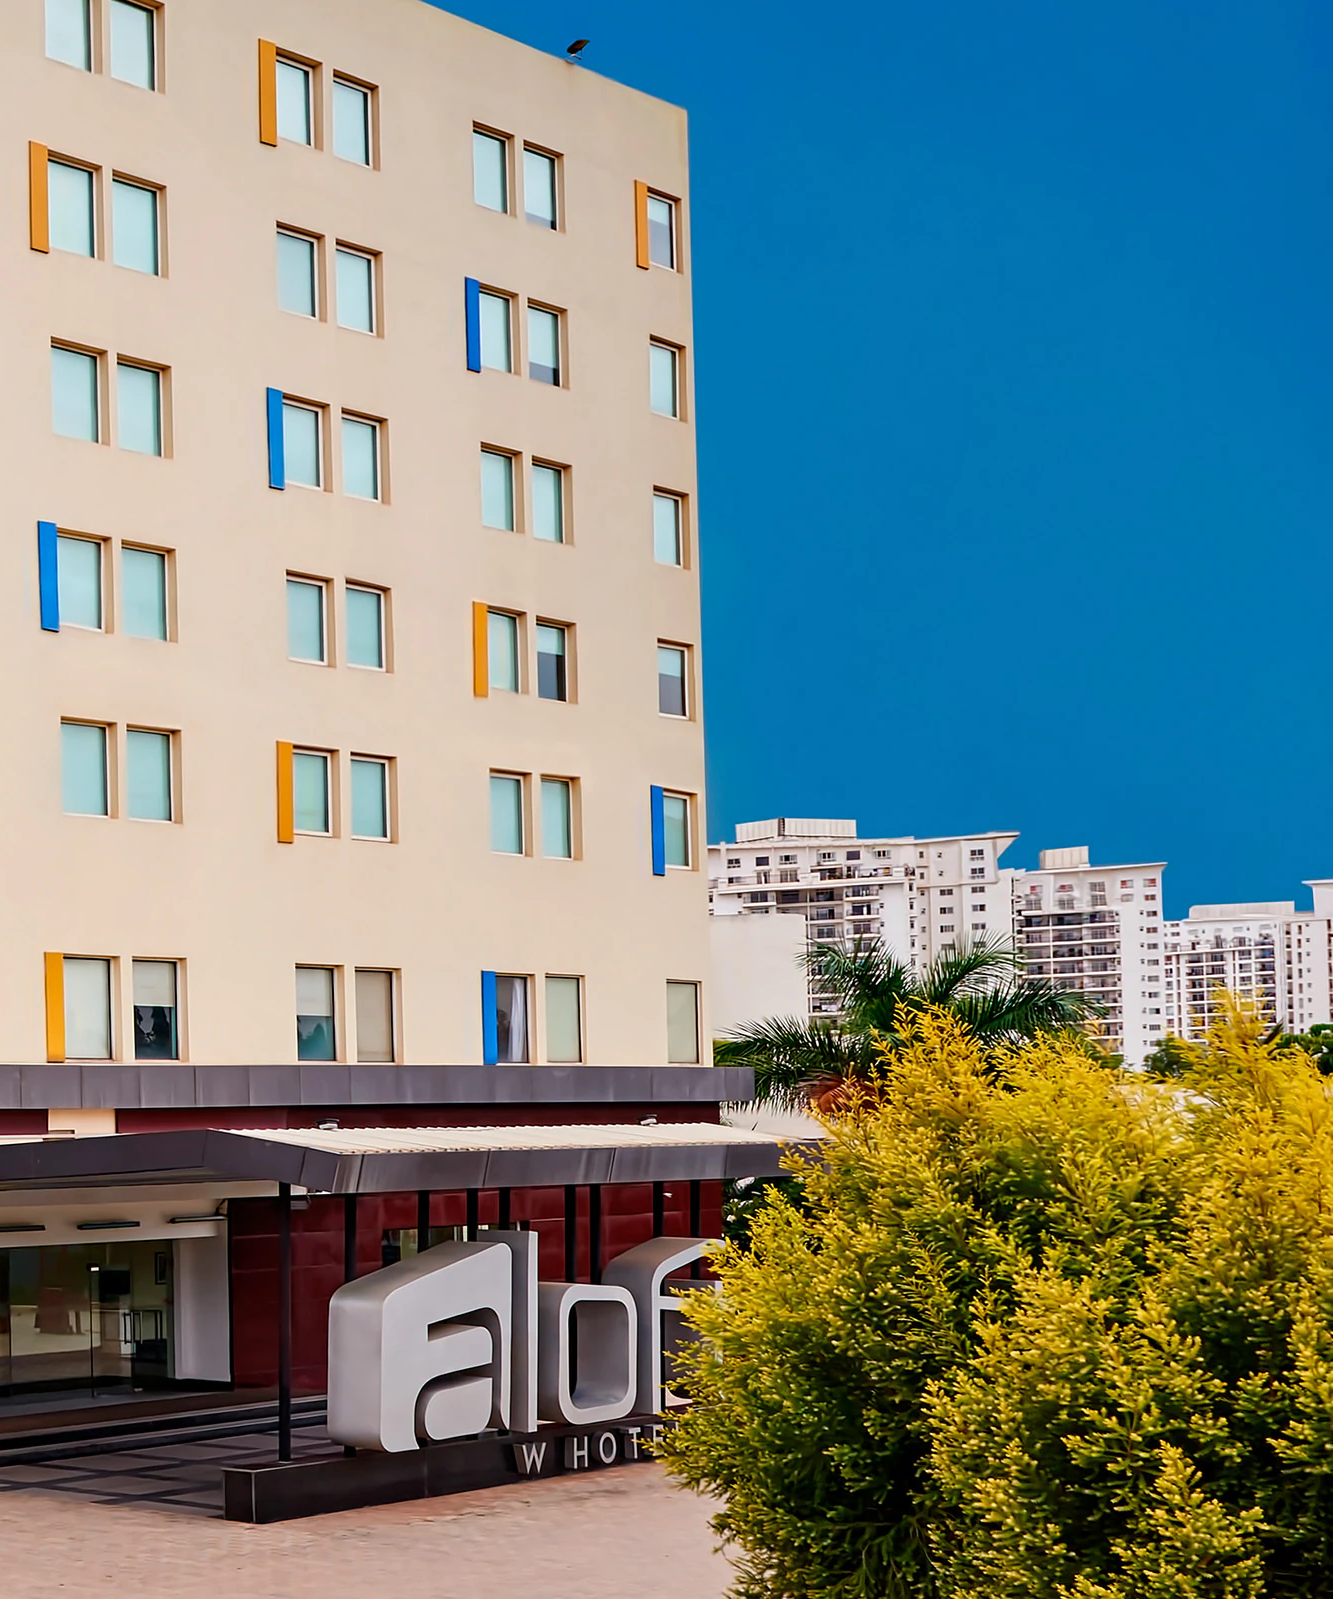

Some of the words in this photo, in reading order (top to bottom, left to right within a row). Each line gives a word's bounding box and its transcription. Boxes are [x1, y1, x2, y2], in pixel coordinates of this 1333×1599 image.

[329, 1230, 727, 1452] alof
[516, 1442, 547, 1475] W
[567, 1422, 680, 1470] HOTE
